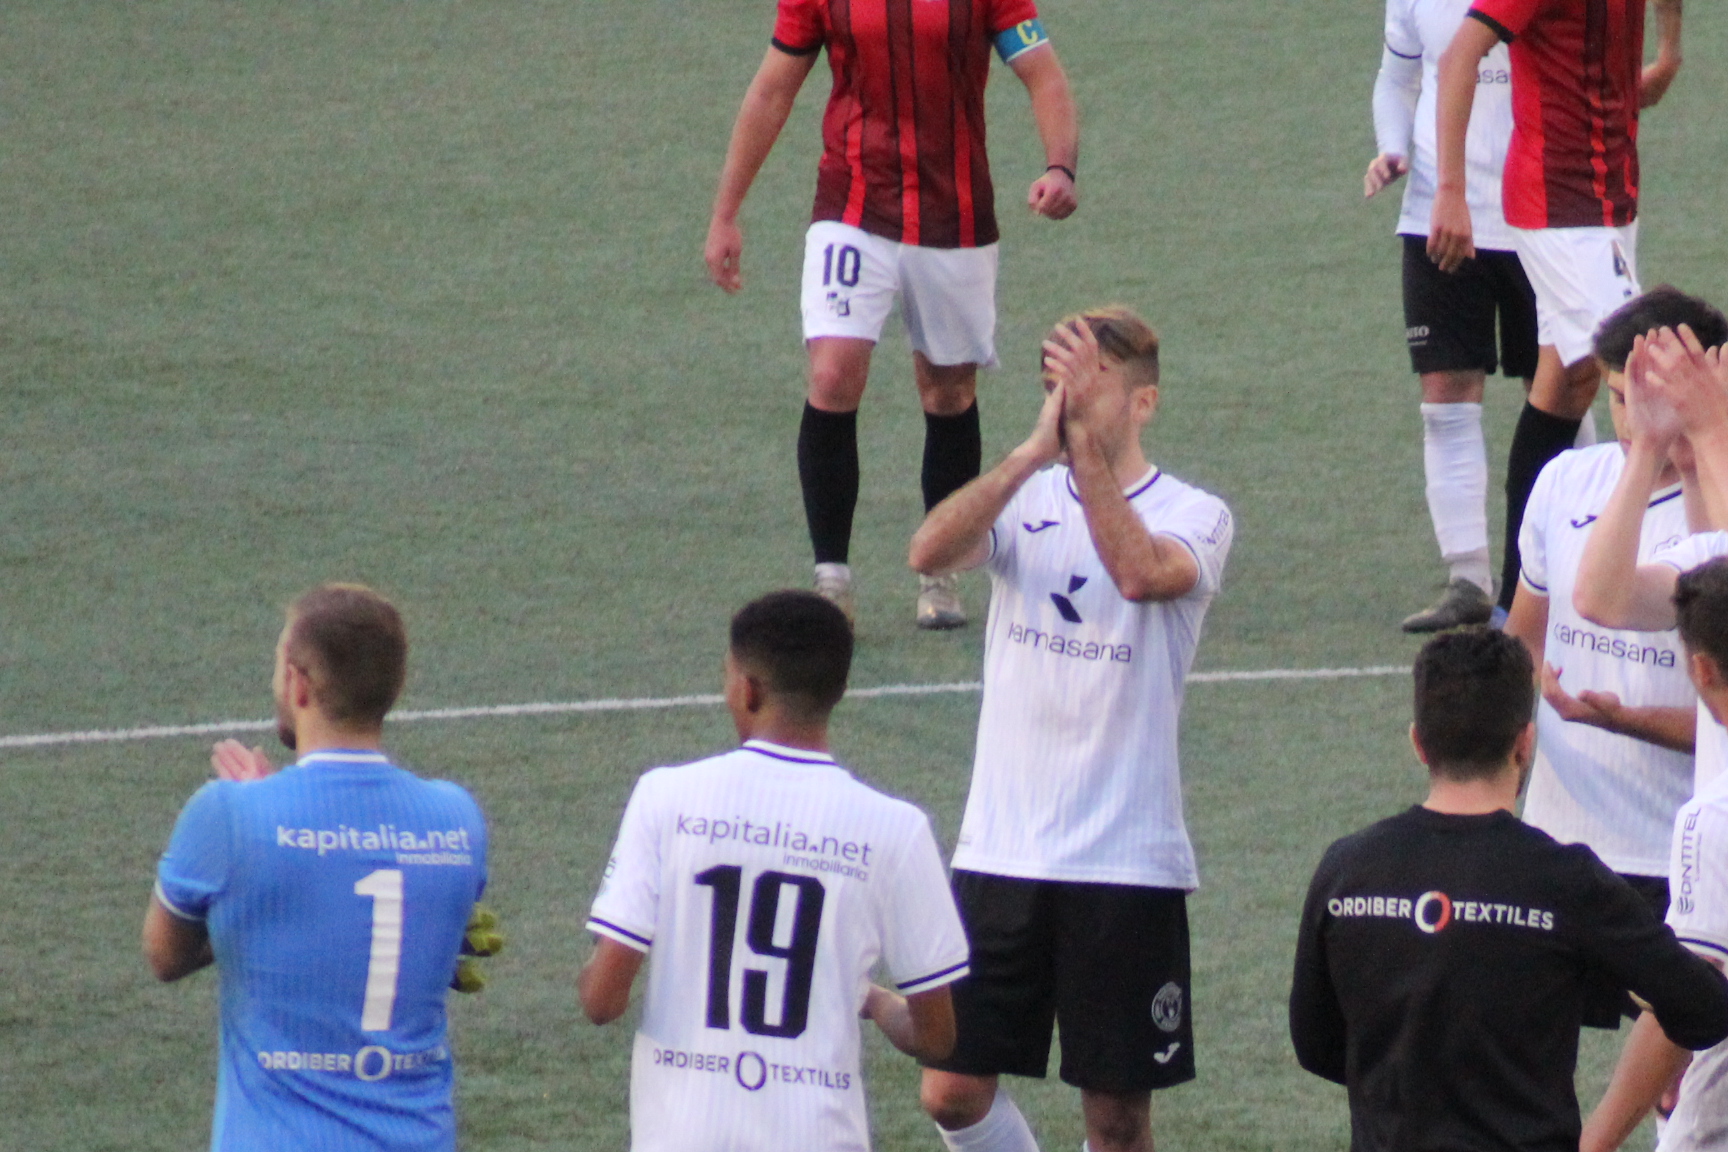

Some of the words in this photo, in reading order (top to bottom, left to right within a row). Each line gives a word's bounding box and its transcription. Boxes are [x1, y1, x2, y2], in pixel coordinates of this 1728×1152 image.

[1016, 19, 1039, 45] C
[823, 243, 861, 288] 10
[276, 823, 470, 856] kapitalia.net
[676, 813, 872, 866] kapitalia.net
[1327, 896, 1412, 918] ORDIBER
[1452, 900, 1554, 931] TEXTILES
[353, 869, 404, 1032] 1
[693, 864, 826, 1039] 19
[769, 1063, 851, 1091] TEXTILES
